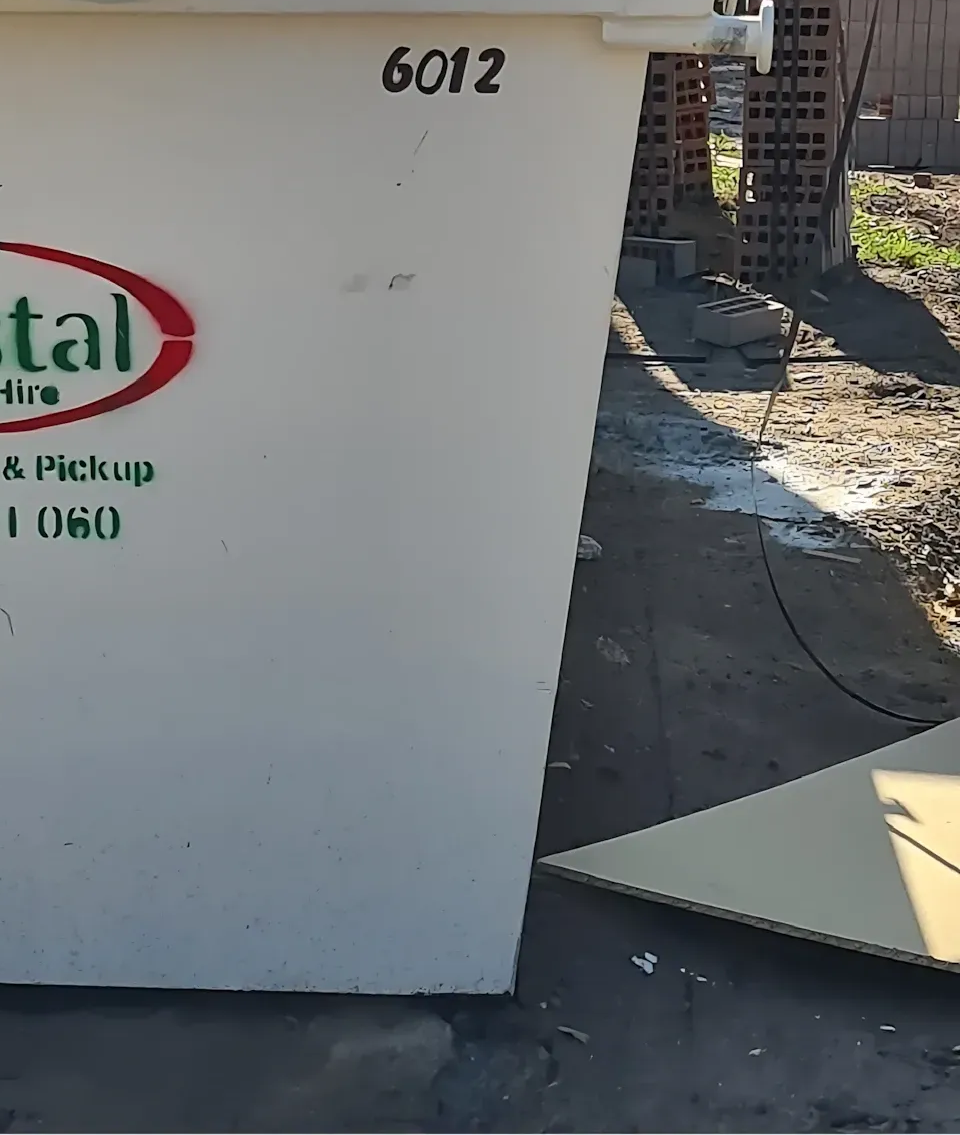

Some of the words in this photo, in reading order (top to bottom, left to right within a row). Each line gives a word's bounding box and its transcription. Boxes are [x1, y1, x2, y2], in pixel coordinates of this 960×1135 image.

[382, 46, 506, 95] 6012
[2, 455, 26, 480] &
[36, 455, 155, 487] Pickup
[37, 506, 121, 539] 060
